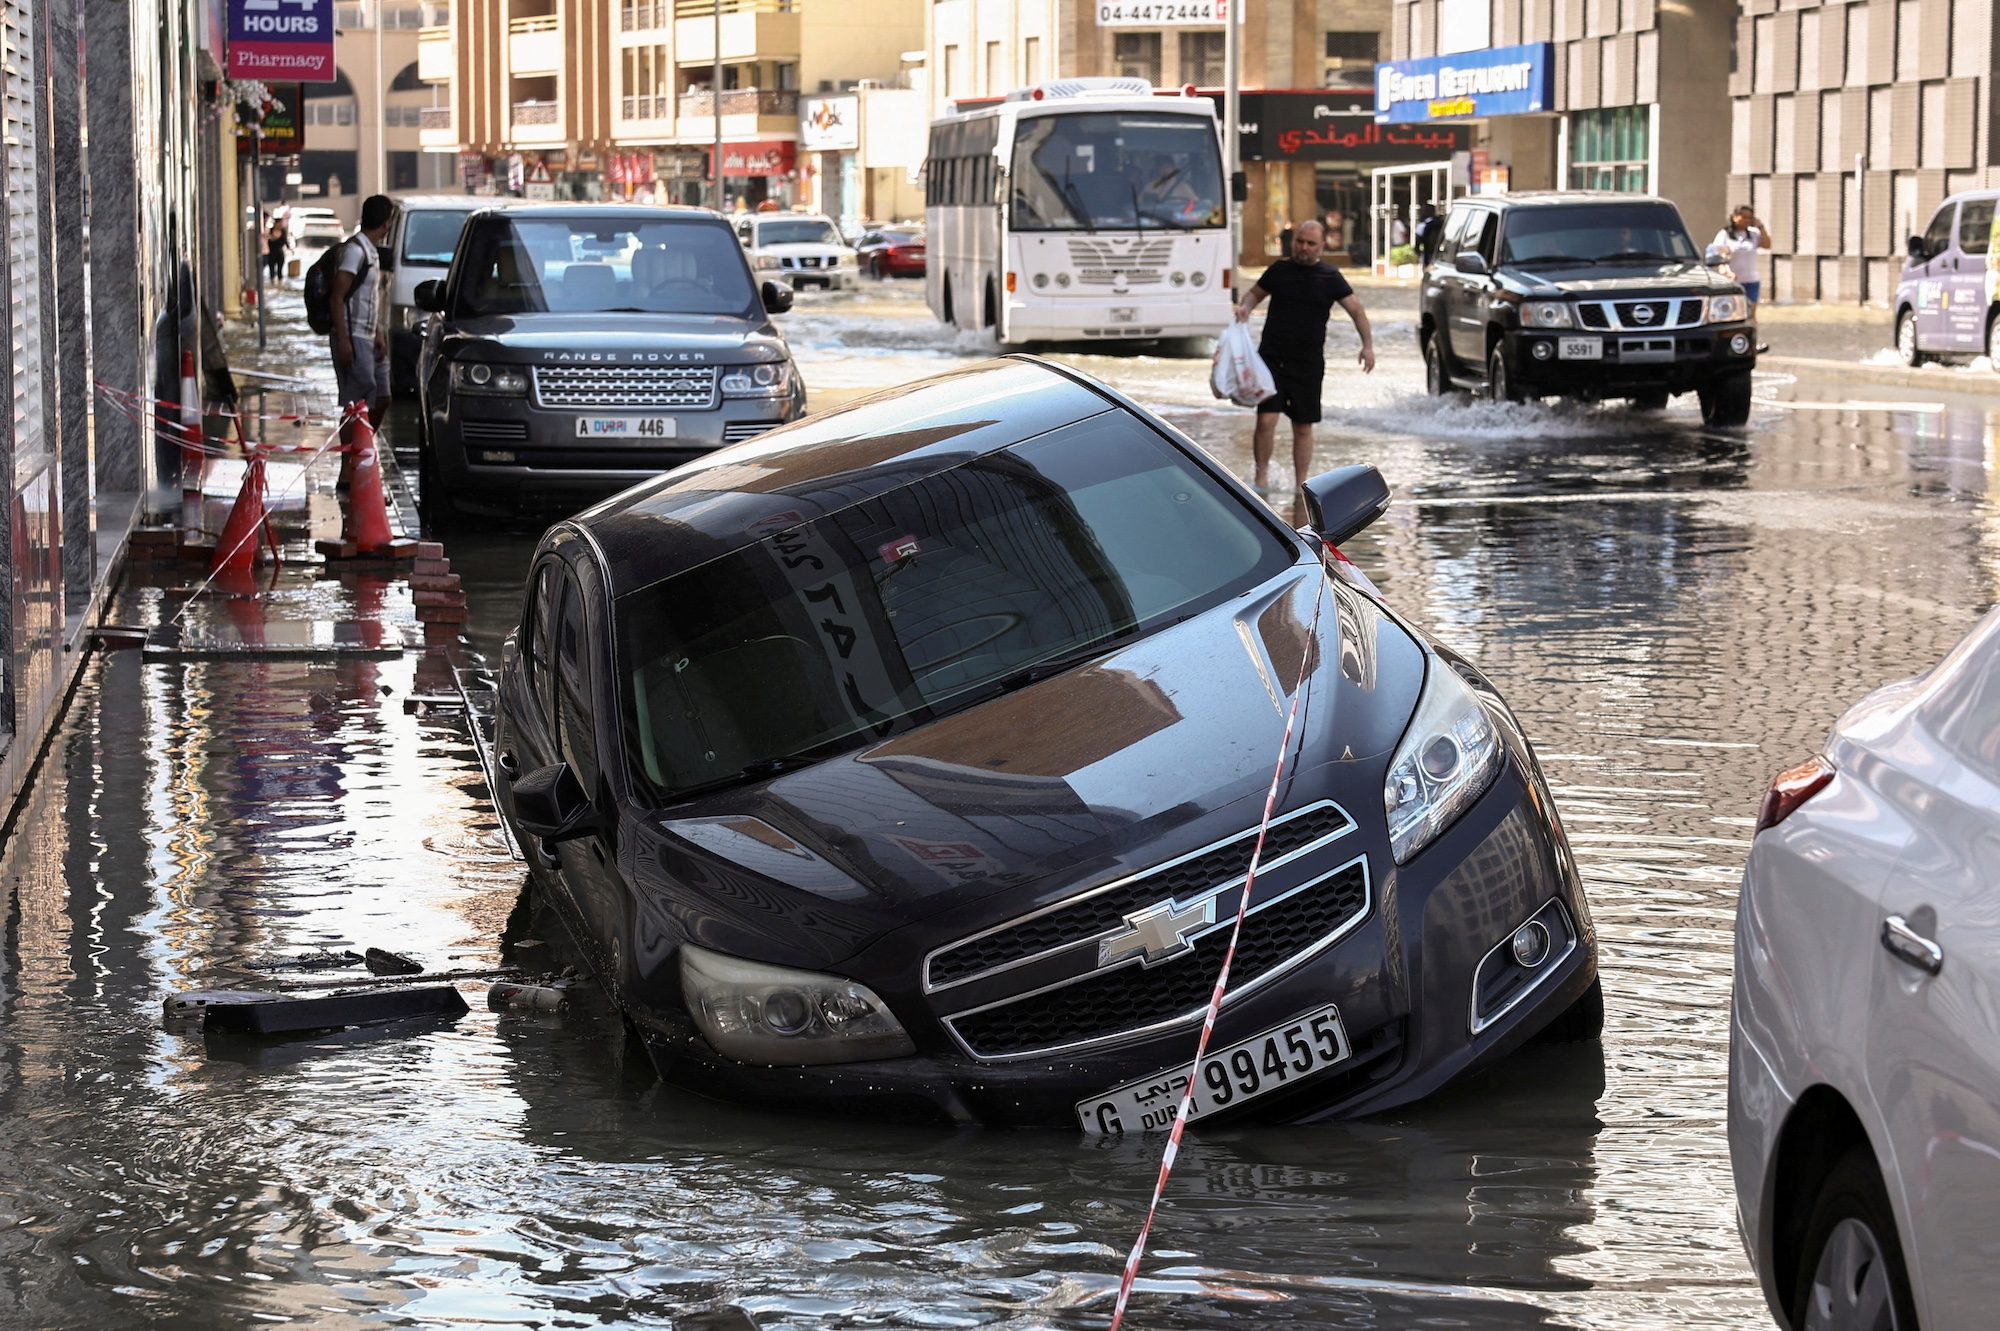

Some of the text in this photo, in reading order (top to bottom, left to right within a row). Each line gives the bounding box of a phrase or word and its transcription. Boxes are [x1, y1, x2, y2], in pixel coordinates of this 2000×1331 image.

[1101, 5, 1210, 21] 04-4472444
[244, 16, 319, 32] HOURS
[237, 51, 325, 70] Pharmacy
[1439, 63, 1531, 97] RESTAURANT
[1386, 124, 1456, 148] بيت
[544, 352, 705, 361] RANGE ROVER
[1567, 343, 1592, 356] 5591
[580, 419, 588, 435] A
[638, 419, 664, 436] 446
[1204, 1013, 1340, 1105] 99455
[1133, 1075, 1189, 1107] دبي
[1096, 1102, 1124, 1134] G
[1141, 1097, 1199, 1130] DUBI
